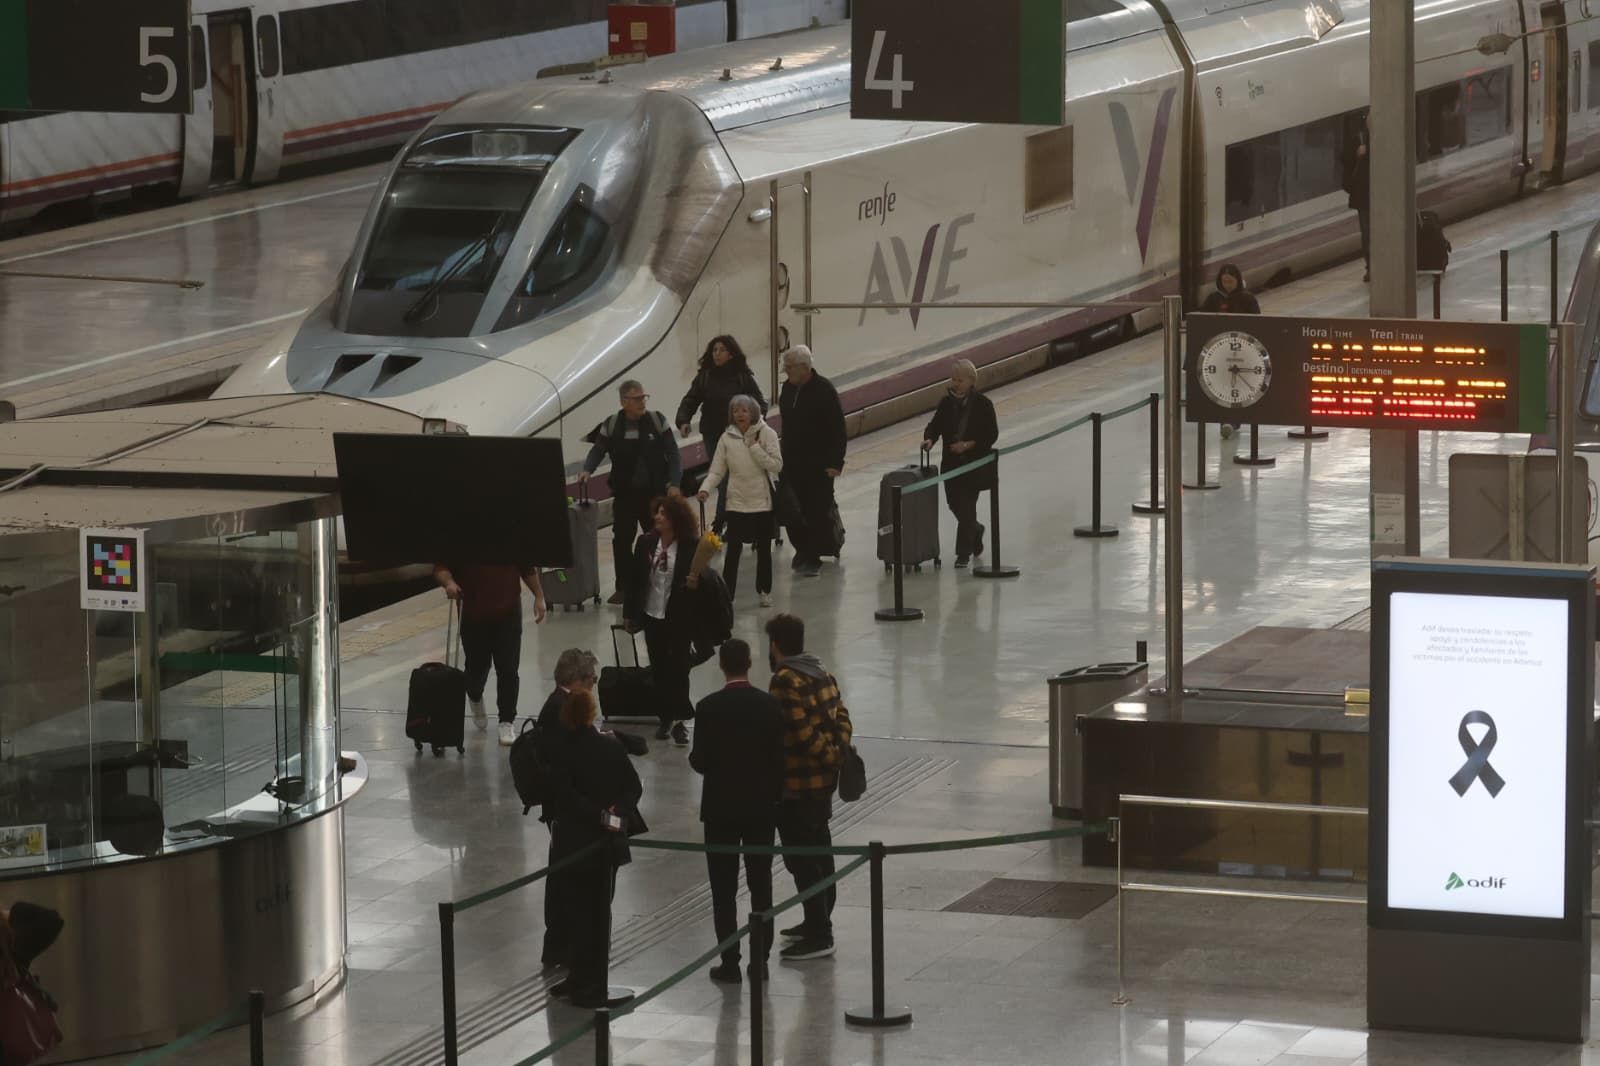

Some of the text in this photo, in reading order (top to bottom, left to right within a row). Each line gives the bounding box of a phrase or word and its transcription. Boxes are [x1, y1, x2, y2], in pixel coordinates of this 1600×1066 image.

[138, 26, 179, 104] 5
[864, 29, 915, 109] 4
[858, 181, 897, 226] renfe
[857, 212, 976, 331] AVE
[1302, 327, 1327, 337] Hora
[1370, 328, 1394, 340] Tren
[1229, 342, 1241, 351] 12
[1208, 365, 1216, 374] 9
[1302, 362, 1392, 375] Destino DESTINATION
[1231, 389, 1239, 397] 6
[1467, 876, 1508, 889] adif
